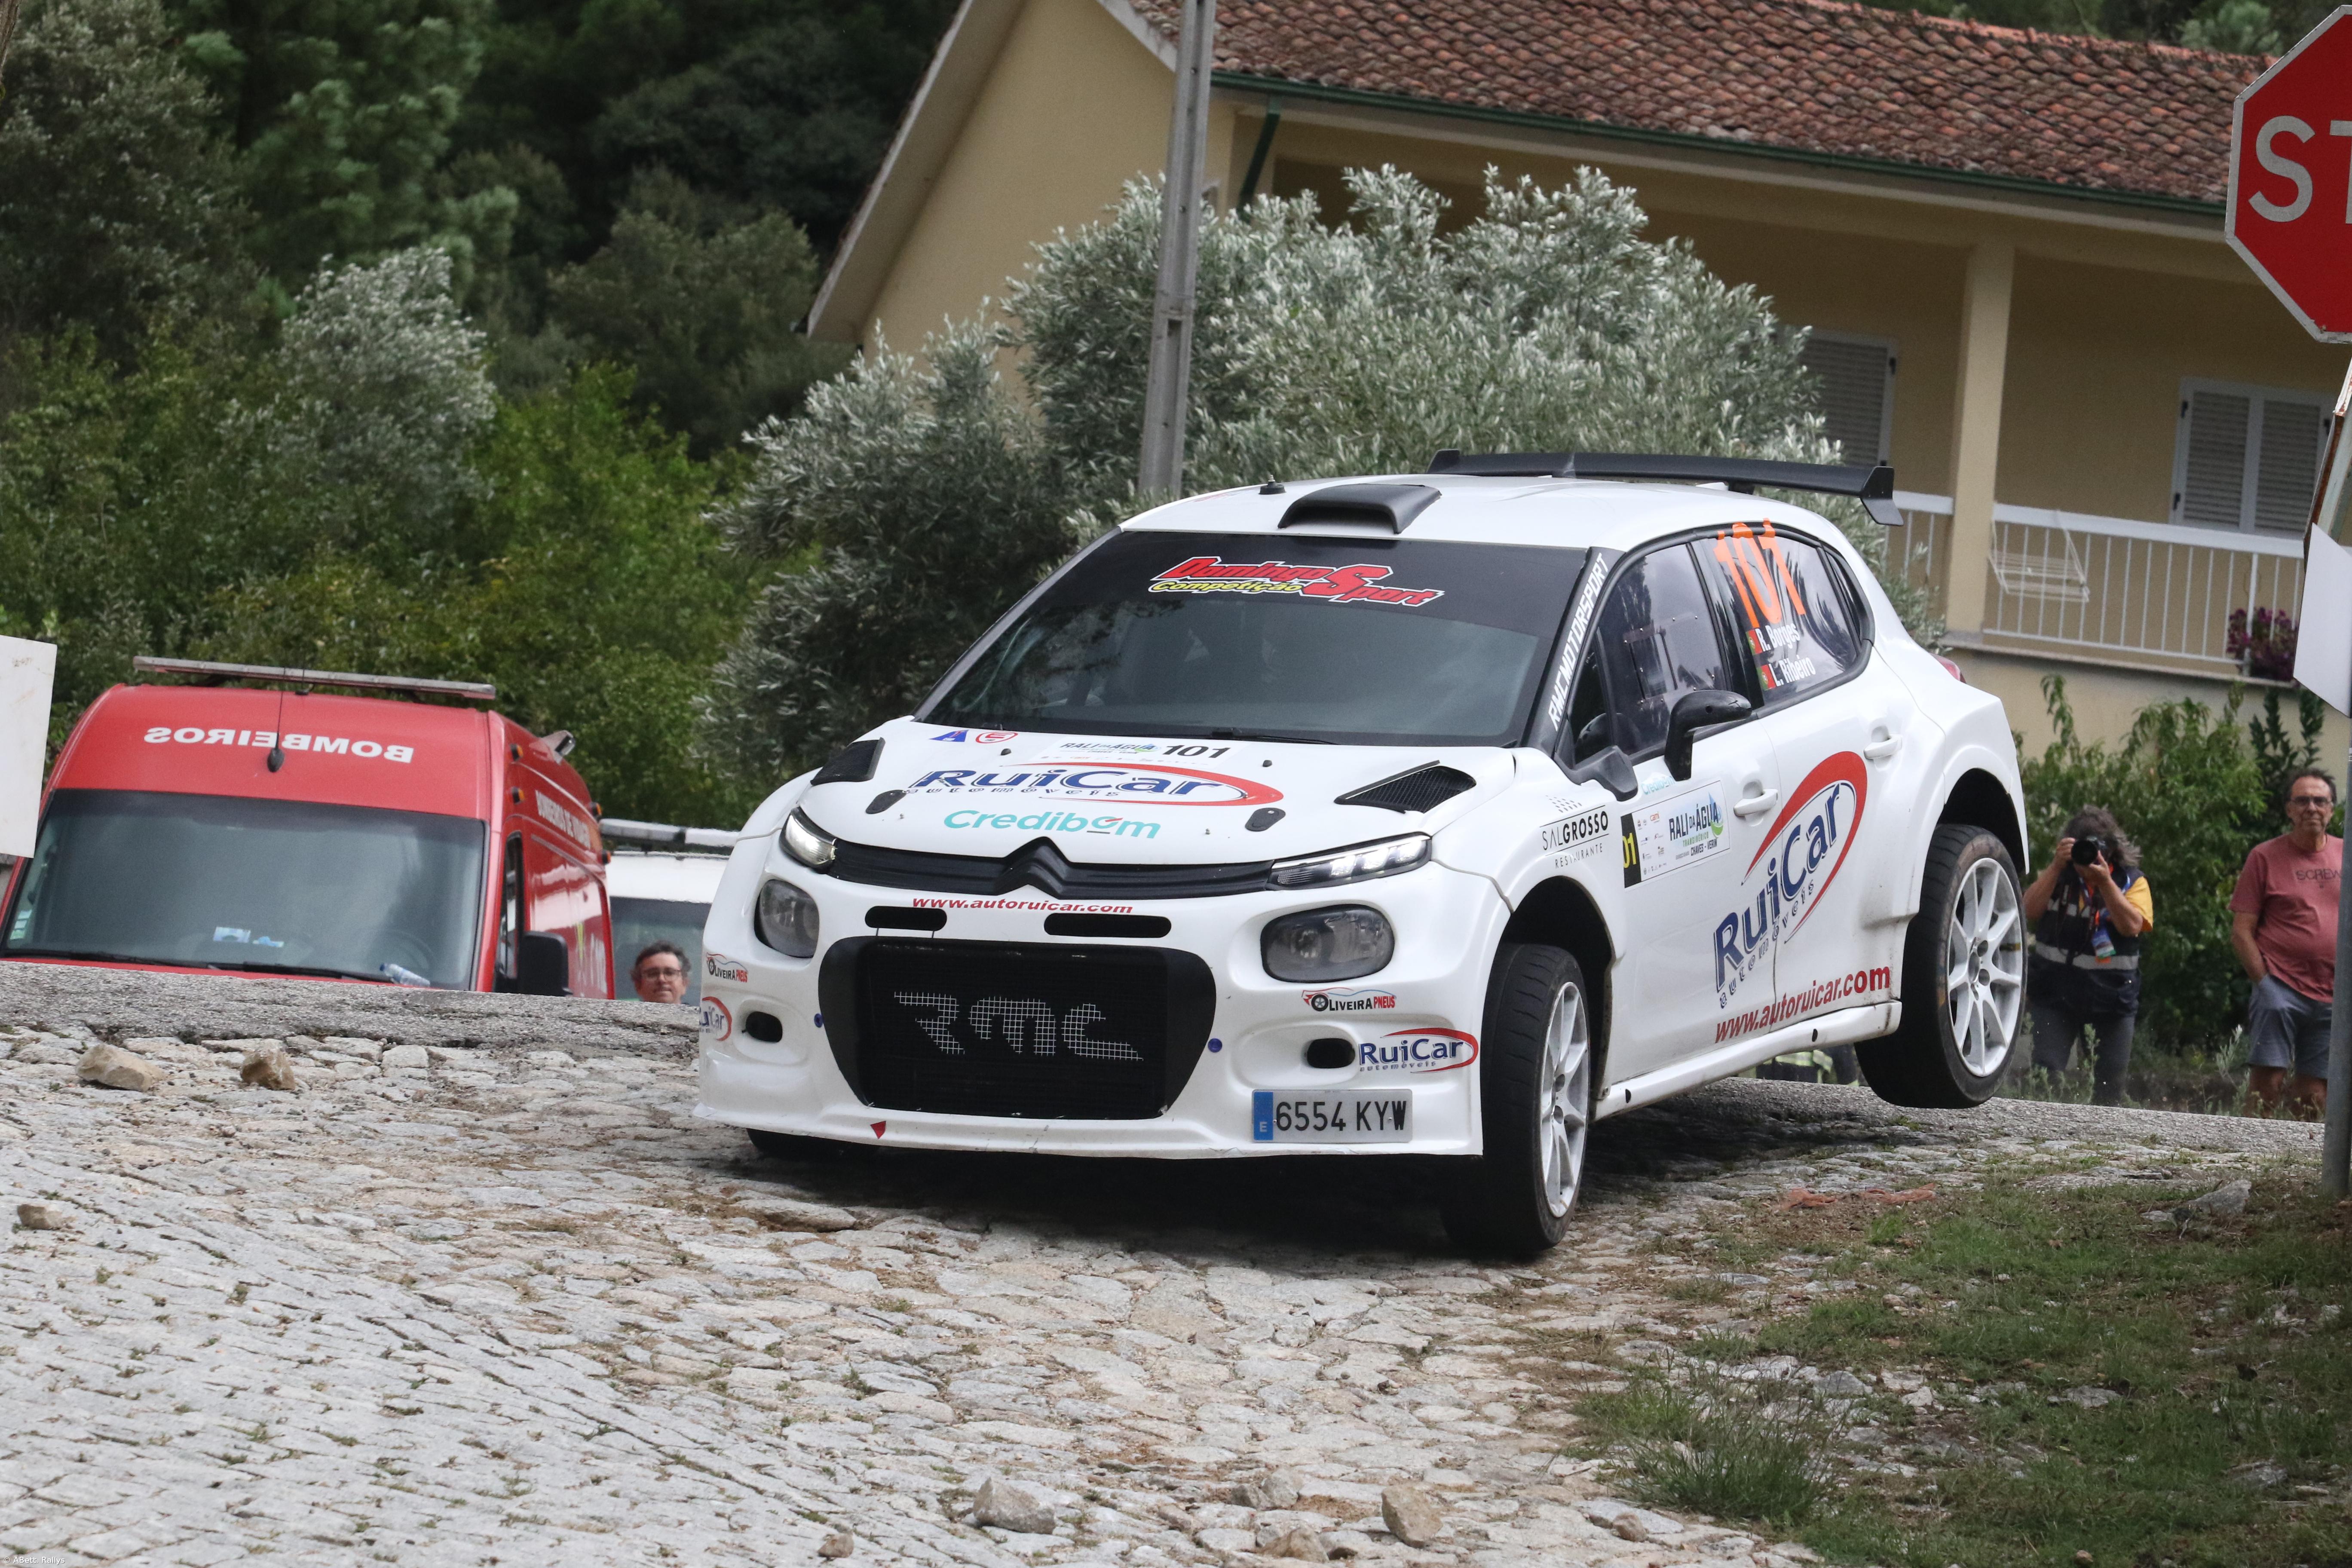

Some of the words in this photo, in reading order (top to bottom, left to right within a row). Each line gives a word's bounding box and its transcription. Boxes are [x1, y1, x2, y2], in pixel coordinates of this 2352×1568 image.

[1150, 579, 1304, 594] Competição
[1713, 518, 1806, 628] 101
[1548, 553, 1608, 732] RMCMOTORSPORT
[1755, 628, 1770, 652] R.
[1765, 623, 1801, 649] Borges
[1768, 663, 1784, 687] L.
[1778, 655, 1816, 683] Ribeiro
[1163, 744, 1231, 759] 101
[908, 769, 1225, 795] RuiCar
[944, 809, 1161, 839] Credibom
[1669, 813, 1689, 841] RALI
[1689, 815, 1696, 829] DA
[1696, 803, 1718, 832] ÁGUA
[1690, 843, 1704, 856] CHAVES
[1713, 782, 1841, 993] RuiCar
[912, 897, 1133, 914] www.autoruicar.com
[699, 1006, 725, 1030] uiCar
[1715, 966, 1890, 1044] www.autoruicar.com
[1358, 1038, 1464, 1065] RuiCar
[1259, 1121, 1268, 1133] E
[1276, 1101, 1347, 1131] 6554
[1356, 1100, 1407, 1131] KYW
